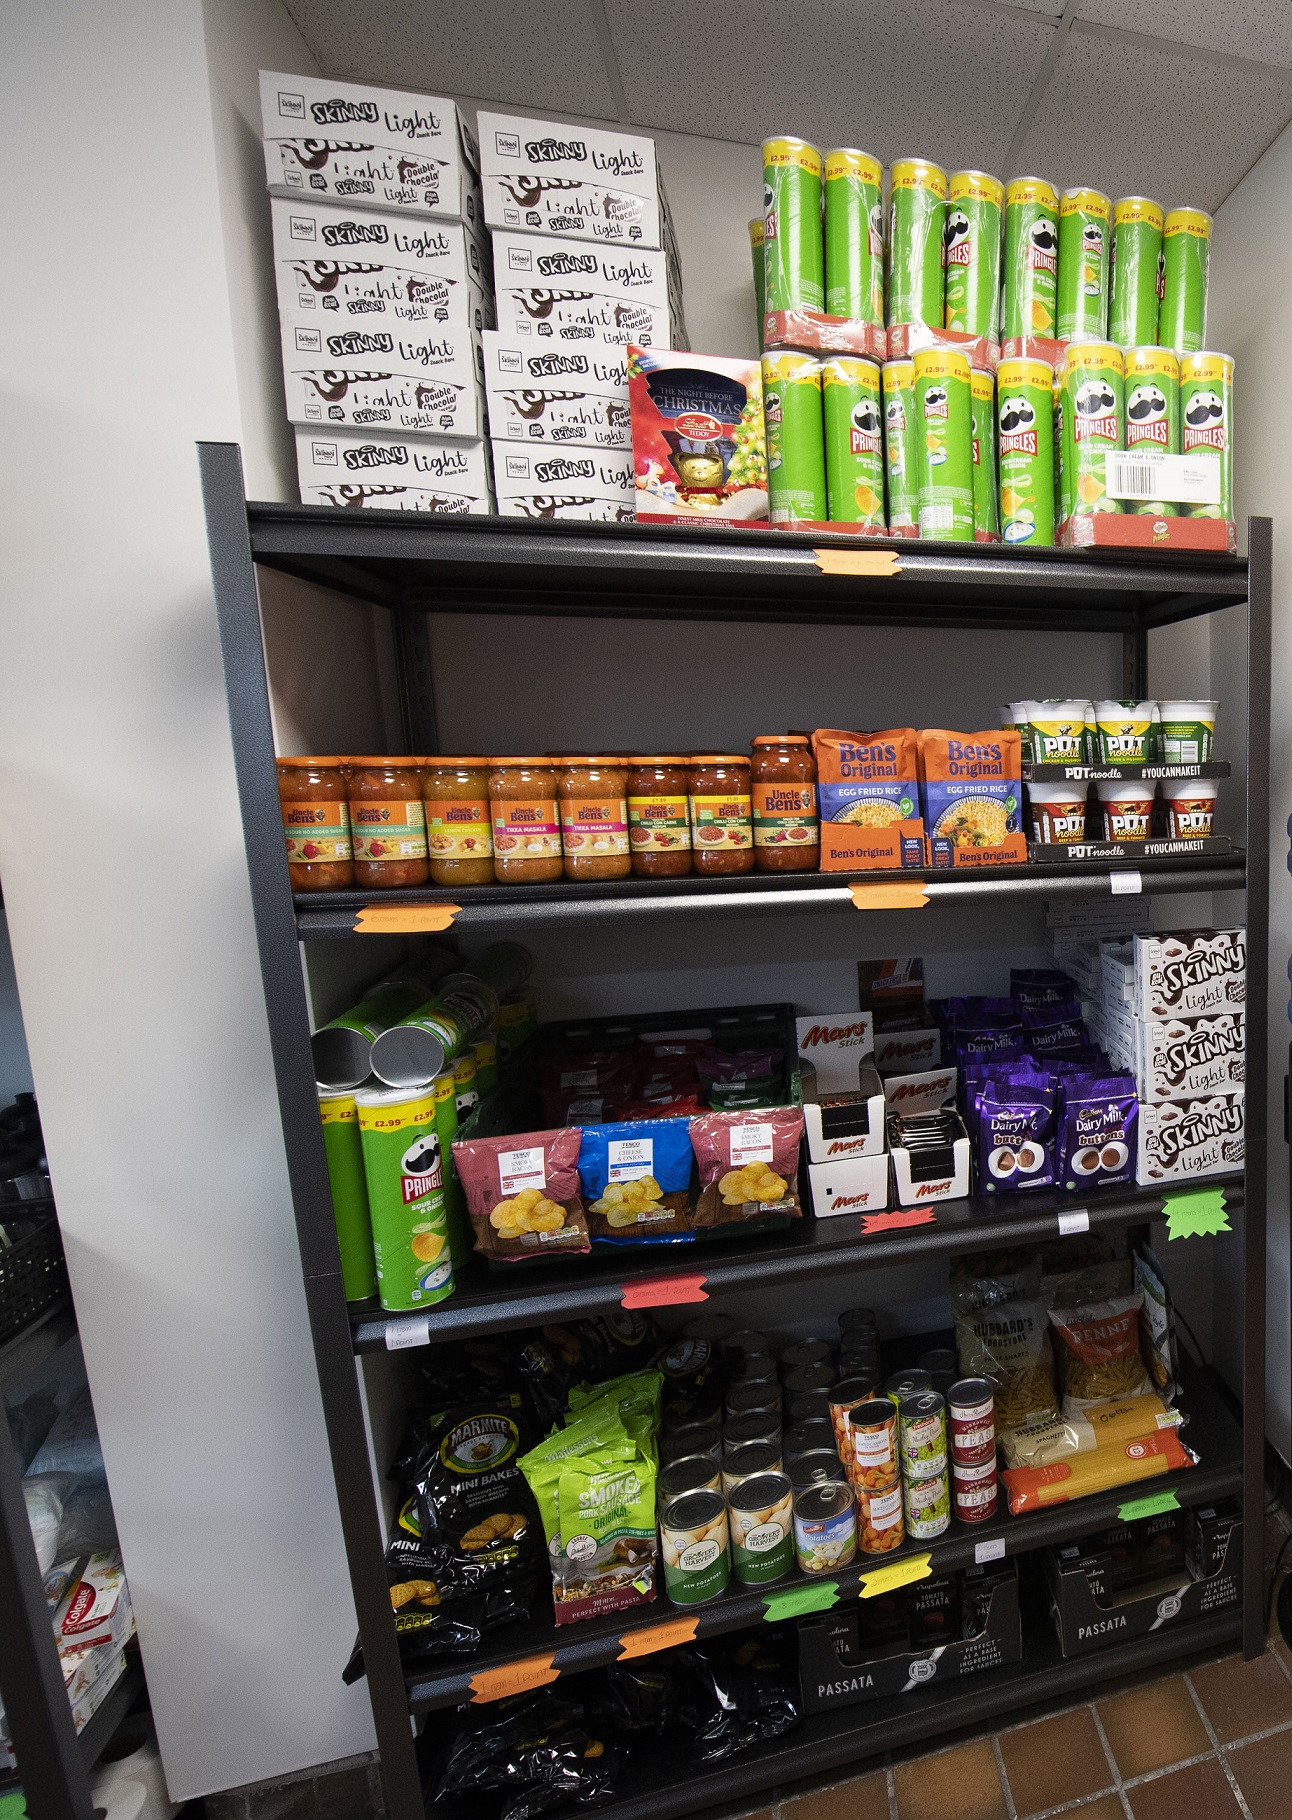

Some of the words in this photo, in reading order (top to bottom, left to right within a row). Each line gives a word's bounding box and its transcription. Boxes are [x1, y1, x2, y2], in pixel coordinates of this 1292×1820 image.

[311, 99, 379, 125] SKINNY
[385, 111, 441, 138] Light
[525, 138, 587, 164] SKINNY
[407, 163, 435, 177] Double
[592, 149, 642, 176] Light
[323, 222, 389, 247] SKINNY
[395, 231, 448, 259] Light
[537, 252, 599, 277] SKINNY
[602, 261, 653, 288] Light
[327, 331, 394, 357] SKINNY
[399, 339, 455, 366] Light
[528, 352, 589, 378] SKINNY
[660, 387, 676, 396] THE
[677, 389, 704, 398] NIGHT
[705, 392, 733, 401] BEFORE
[652, 395, 742, 416] CHRISTMAS
[924, 406, 948, 419] PRINGLES
[689, 430, 710, 438] TEDDY
[1074, 416, 1118, 443] PRINGLES
[1127, 420, 1168, 445] PRINGLES
[1184, 427, 1225, 451] PRINGLES
[1000, 432, 1036, 456] PRINGLES
[343, 445, 409, 471] SKINNY
[414, 451, 468, 478] Light
[534, 459, 595, 483] SKINNY
[839, 743, 896, 762] Ben's
[948, 740, 1002, 761] Ben's
[1043, 736, 1082, 751] POT
[1045, 747, 1080, 759] noodle
[841, 763, 897, 780] Original
[949, 762, 1002, 778] Original
[1065, 767, 1091, 780] POT
[1089, 768, 1122, 780] noodle
[1142, 765, 1201, 778] #YOUCANMAKEIT
[772, 790, 800, 800] Uncle
[839, 788, 857, 796] EGG
[885, 787, 902, 795] RICE
[947, 786, 963, 794] EGG
[990, 785, 1007, 793] RICE
[830, 850, 855, 859] Ben's
[856, 850, 893, 859] Original
[960, 853, 982, 862] Ben's
[984, 851, 1017, 861] Original
[1068, 845, 1094, 858] POT
[1092, 846, 1125, 857] noodle
[1144, 840, 1204, 855] #YOUCANMAKEIT
[1163, 944, 1246, 992] SKINNY
[1186, 987, 1223, 1010] Light
[801, 1020, 868, 1049] Mars
[838, 1036, 865, 1048] Stick
[374, 1118, 401, 1128] £2.99
[1076, 1115, 1101, 1132] Dairy
[1103, 1111, 1125, 1124] Milk
[1160, 1107, 1244, 1154] SKINNY
[1079, 1131, 1125, 1145] buttons
[618, 1149, 644, 1158] CHEESE
[623, 1153, 644, 1161] ONION
[1182, 1149, 1220, 1171] Light
[916, 1181, 952, 1198] Mars
[973, 1318, 1033, 1338] HUBBARD'S
[1072, 1318, 1131, 1343] PENNE
[451, 1419, 508, 1448] MARMITE
[962, 1432, 991, 1446] PEAS
[450, 1478, 479, 1494] MINI
[480, 1468, 520, 1486] BAKES
[579, 1476, 641, 1509] SMOKED
[578, 1507, 599, 1520] PORK
[600, 1493, 642, 1517] SAUSAGE
[805, 1532, 835, 1541] Potatoes
[685, 1552, 715, 1567] HARVEST
[696, 1571, 721, 1587] POTATOES
[66, 1589, 90, 1625] Colgate
[572, 1606, 600, 1619] PERFECT
[602, 1601, 620, 1612] WITH
[621, 1596, 641, 1608] PASTA
[64, 1619, 100, 1634] Colgate
[1078, 1616, 1127, 1640] PASSATA
[818, 1674, 874, 1698] PASSATA
